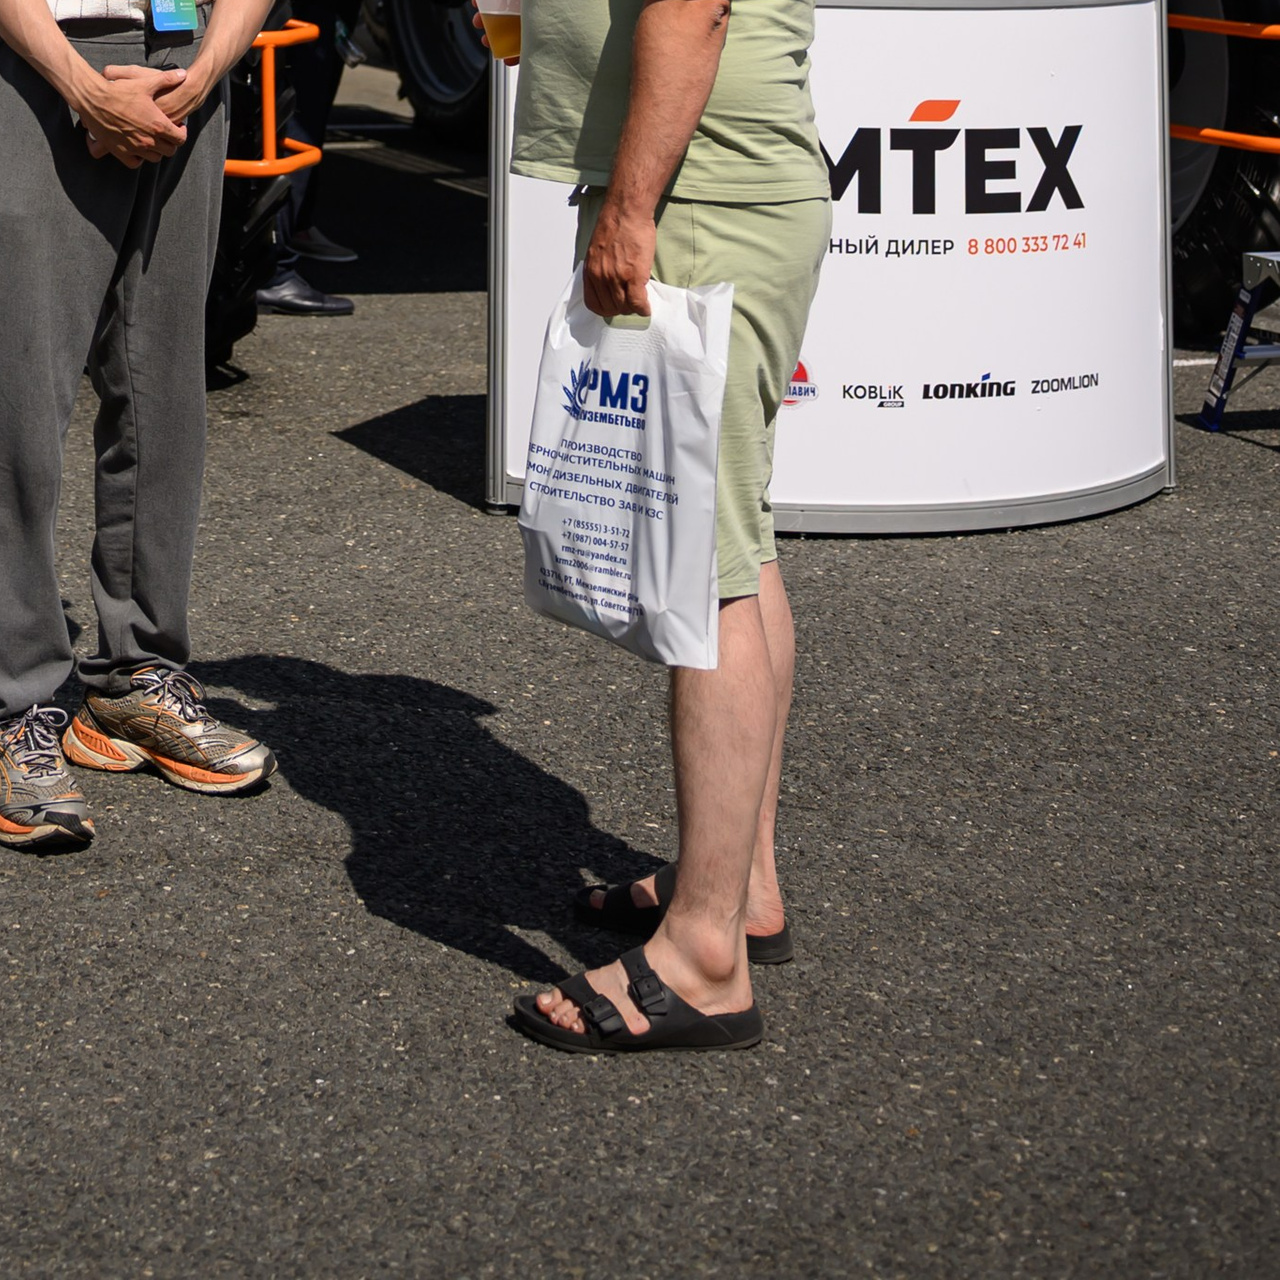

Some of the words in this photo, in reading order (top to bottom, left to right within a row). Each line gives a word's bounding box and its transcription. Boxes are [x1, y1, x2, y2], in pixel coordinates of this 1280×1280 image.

[819, 102, 1085, 214] МТЕХ
[829, 235, 878, 254] НЫЙ
[885, 239, 954, 257] ДИЛЕР
[967, 239, 979, 255] 8
[984, 238, 1017, 254] 800
[1022, 236, 1048, 253] 333
[1052, 234, 1069, 251] 72
[1073, 232, 1086, 248] 41
[785, 385, 816, 397] ЛАВИЧ
[1031, 373, 1099, 394] ZOOMLION
[552, 469, 622, 491] ДИЗЕЛЬНЫХ
[562, 518, 572, 527] +7
[573, 518, 602, 534] (85555)
[603, 525, 630, 539] 3-51-72
[561, 531, 572, 540] +7
[572, 533, 592, 545] (987)
[593, 537, 629, 552] 004-57-57
